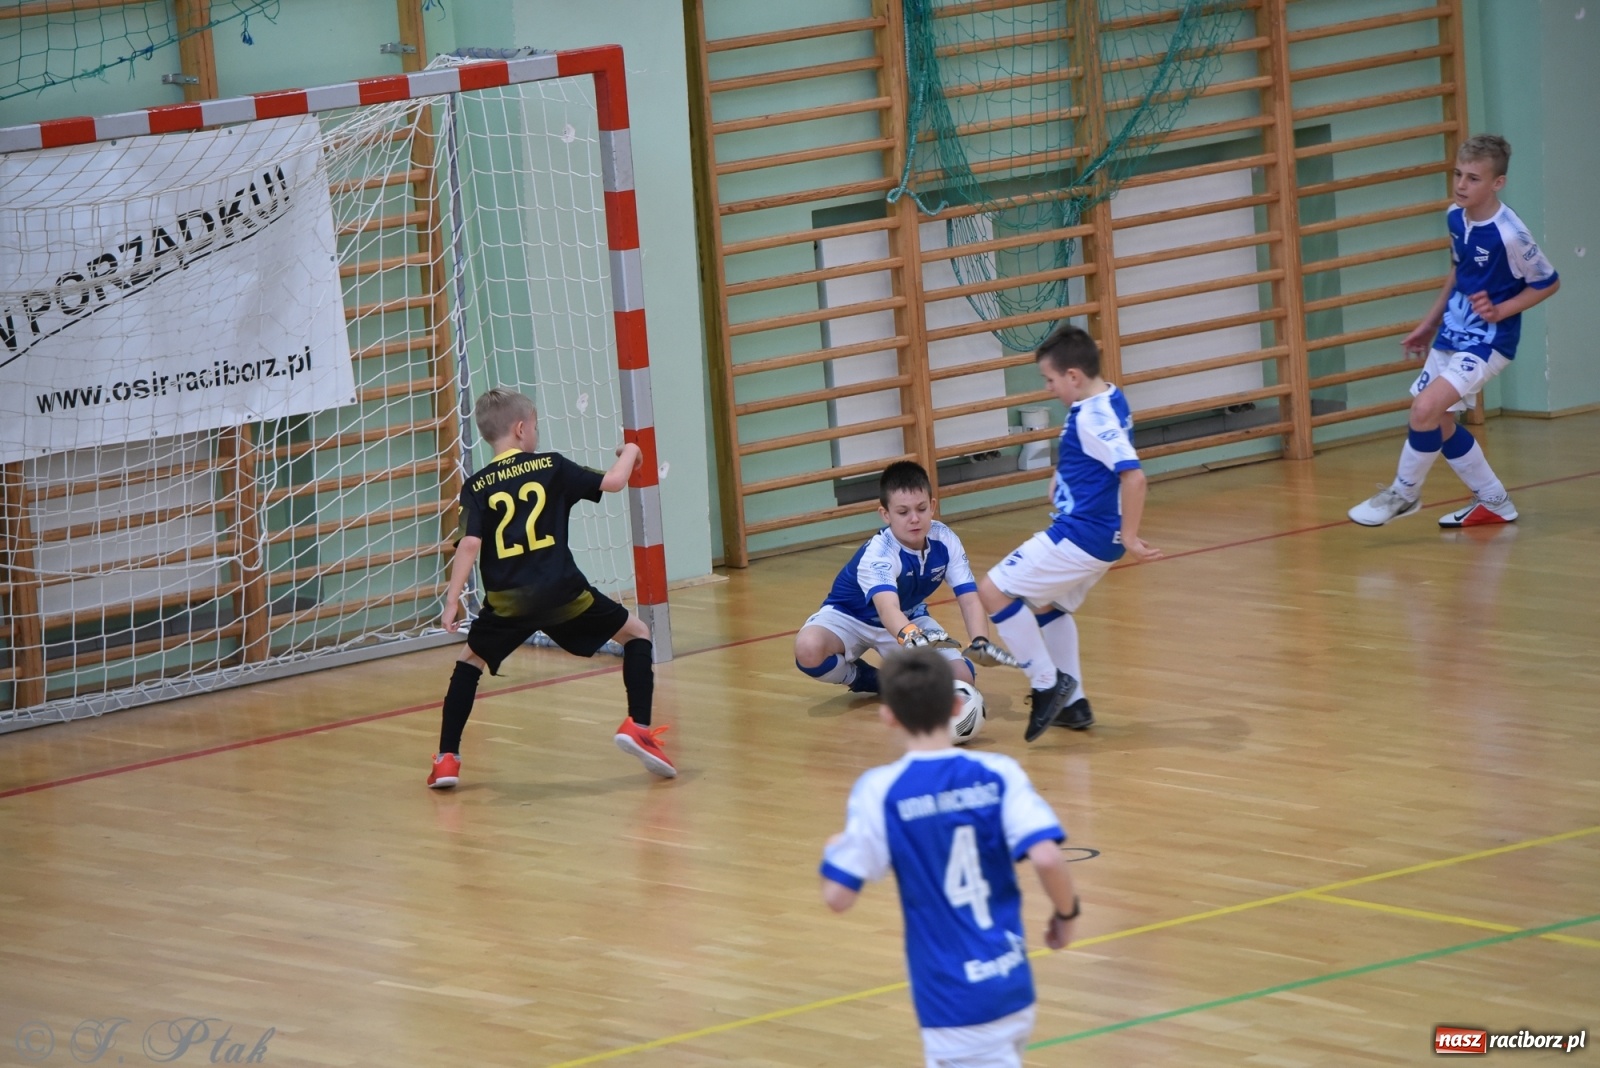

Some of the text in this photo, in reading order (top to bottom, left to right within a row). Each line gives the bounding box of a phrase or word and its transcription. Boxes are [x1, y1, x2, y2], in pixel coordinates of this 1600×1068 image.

[485, 472, 496, 486] 07
[497, 456, 553, 482] MARKOWICE
[488, 481, 556, 560] 22
[944, 825, 993, 930] 4
